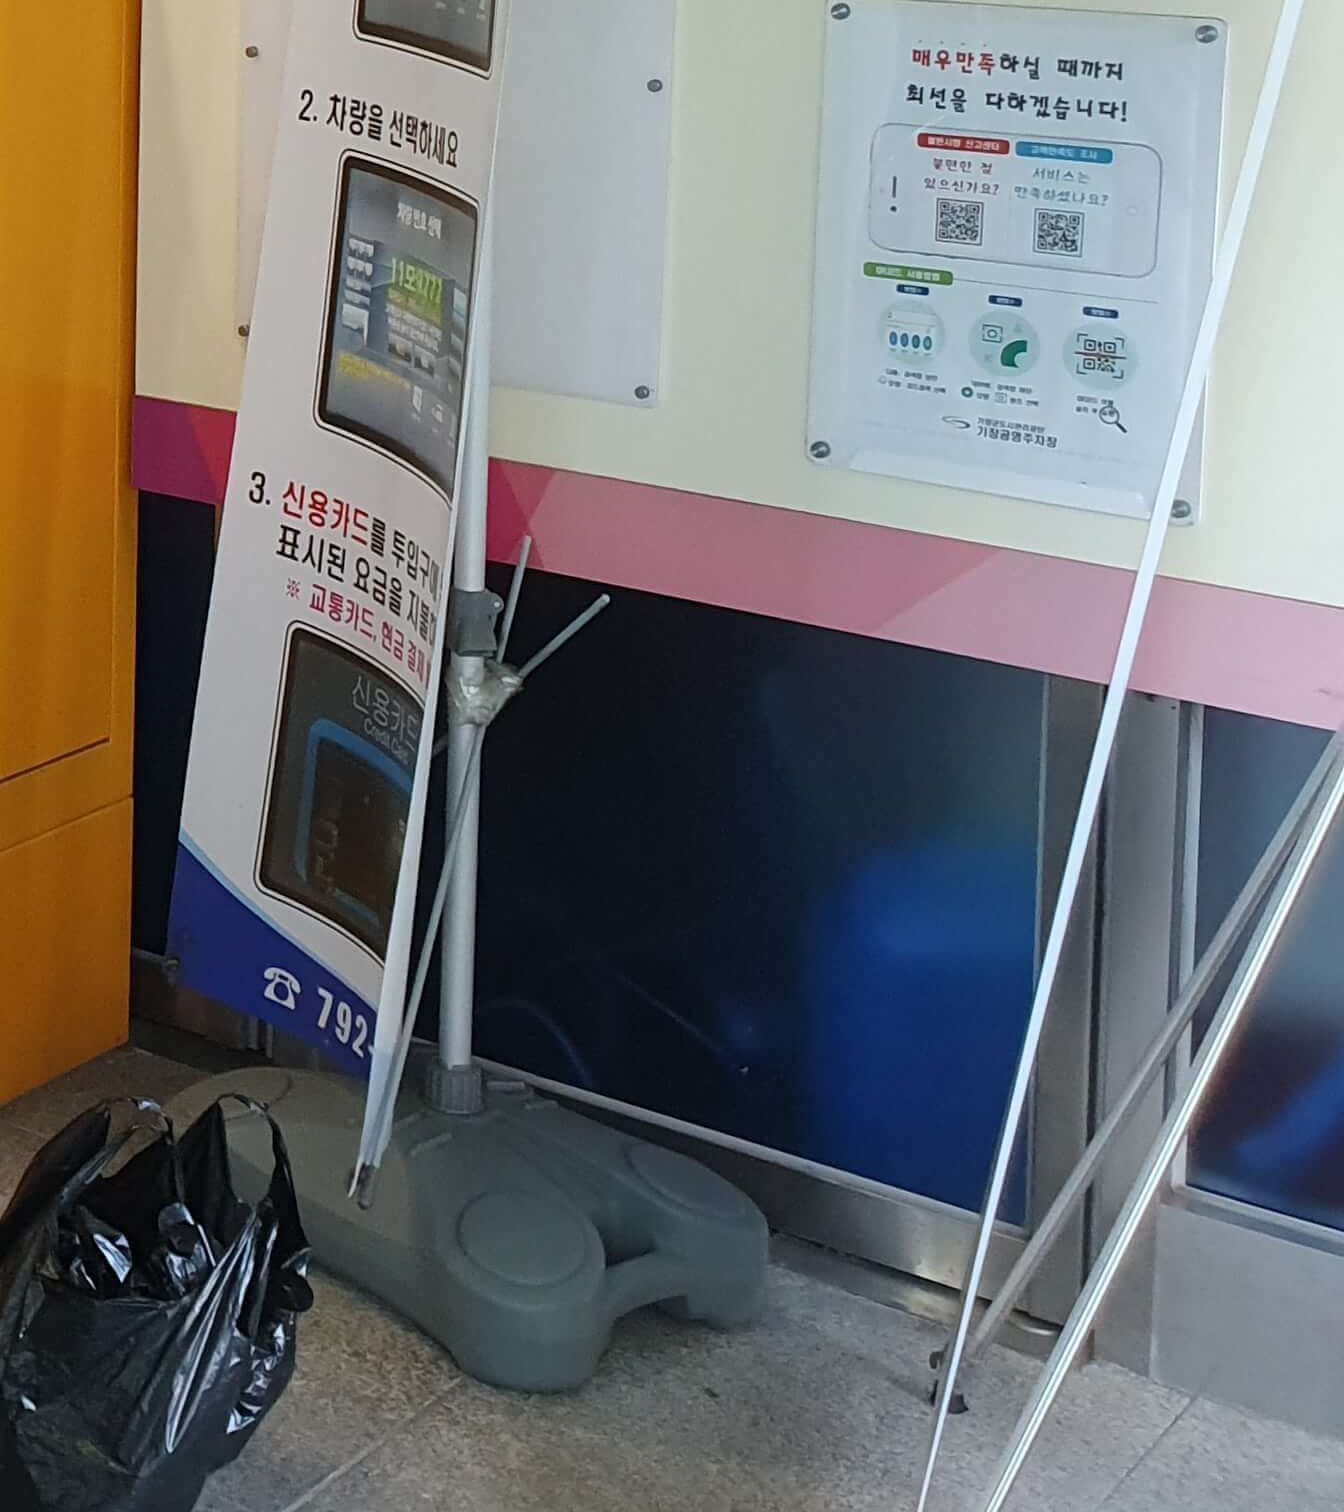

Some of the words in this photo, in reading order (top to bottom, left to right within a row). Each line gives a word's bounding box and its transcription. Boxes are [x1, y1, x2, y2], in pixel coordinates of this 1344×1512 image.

[911, 48, 1042, 81] 매우만족하실
[1057, 58, 1125, 82] 때까지
[298, 90, 318, 124] 2.
[326, 93, 384, 144] 차량을
[389, 109, 461, 170] 선택하세요
[905, 83, 968, 114] 최선을
[985, 90, 1129, 123] 다하겠습니다!
[248, 472, 272, 507] 3.
[282, 481, 387, 558] 신용카드를
[275, 524, 347, 584] 표시된
[353, 556, 403, 617] 요금을
[309, 583, 378, 643] 교통카드,
